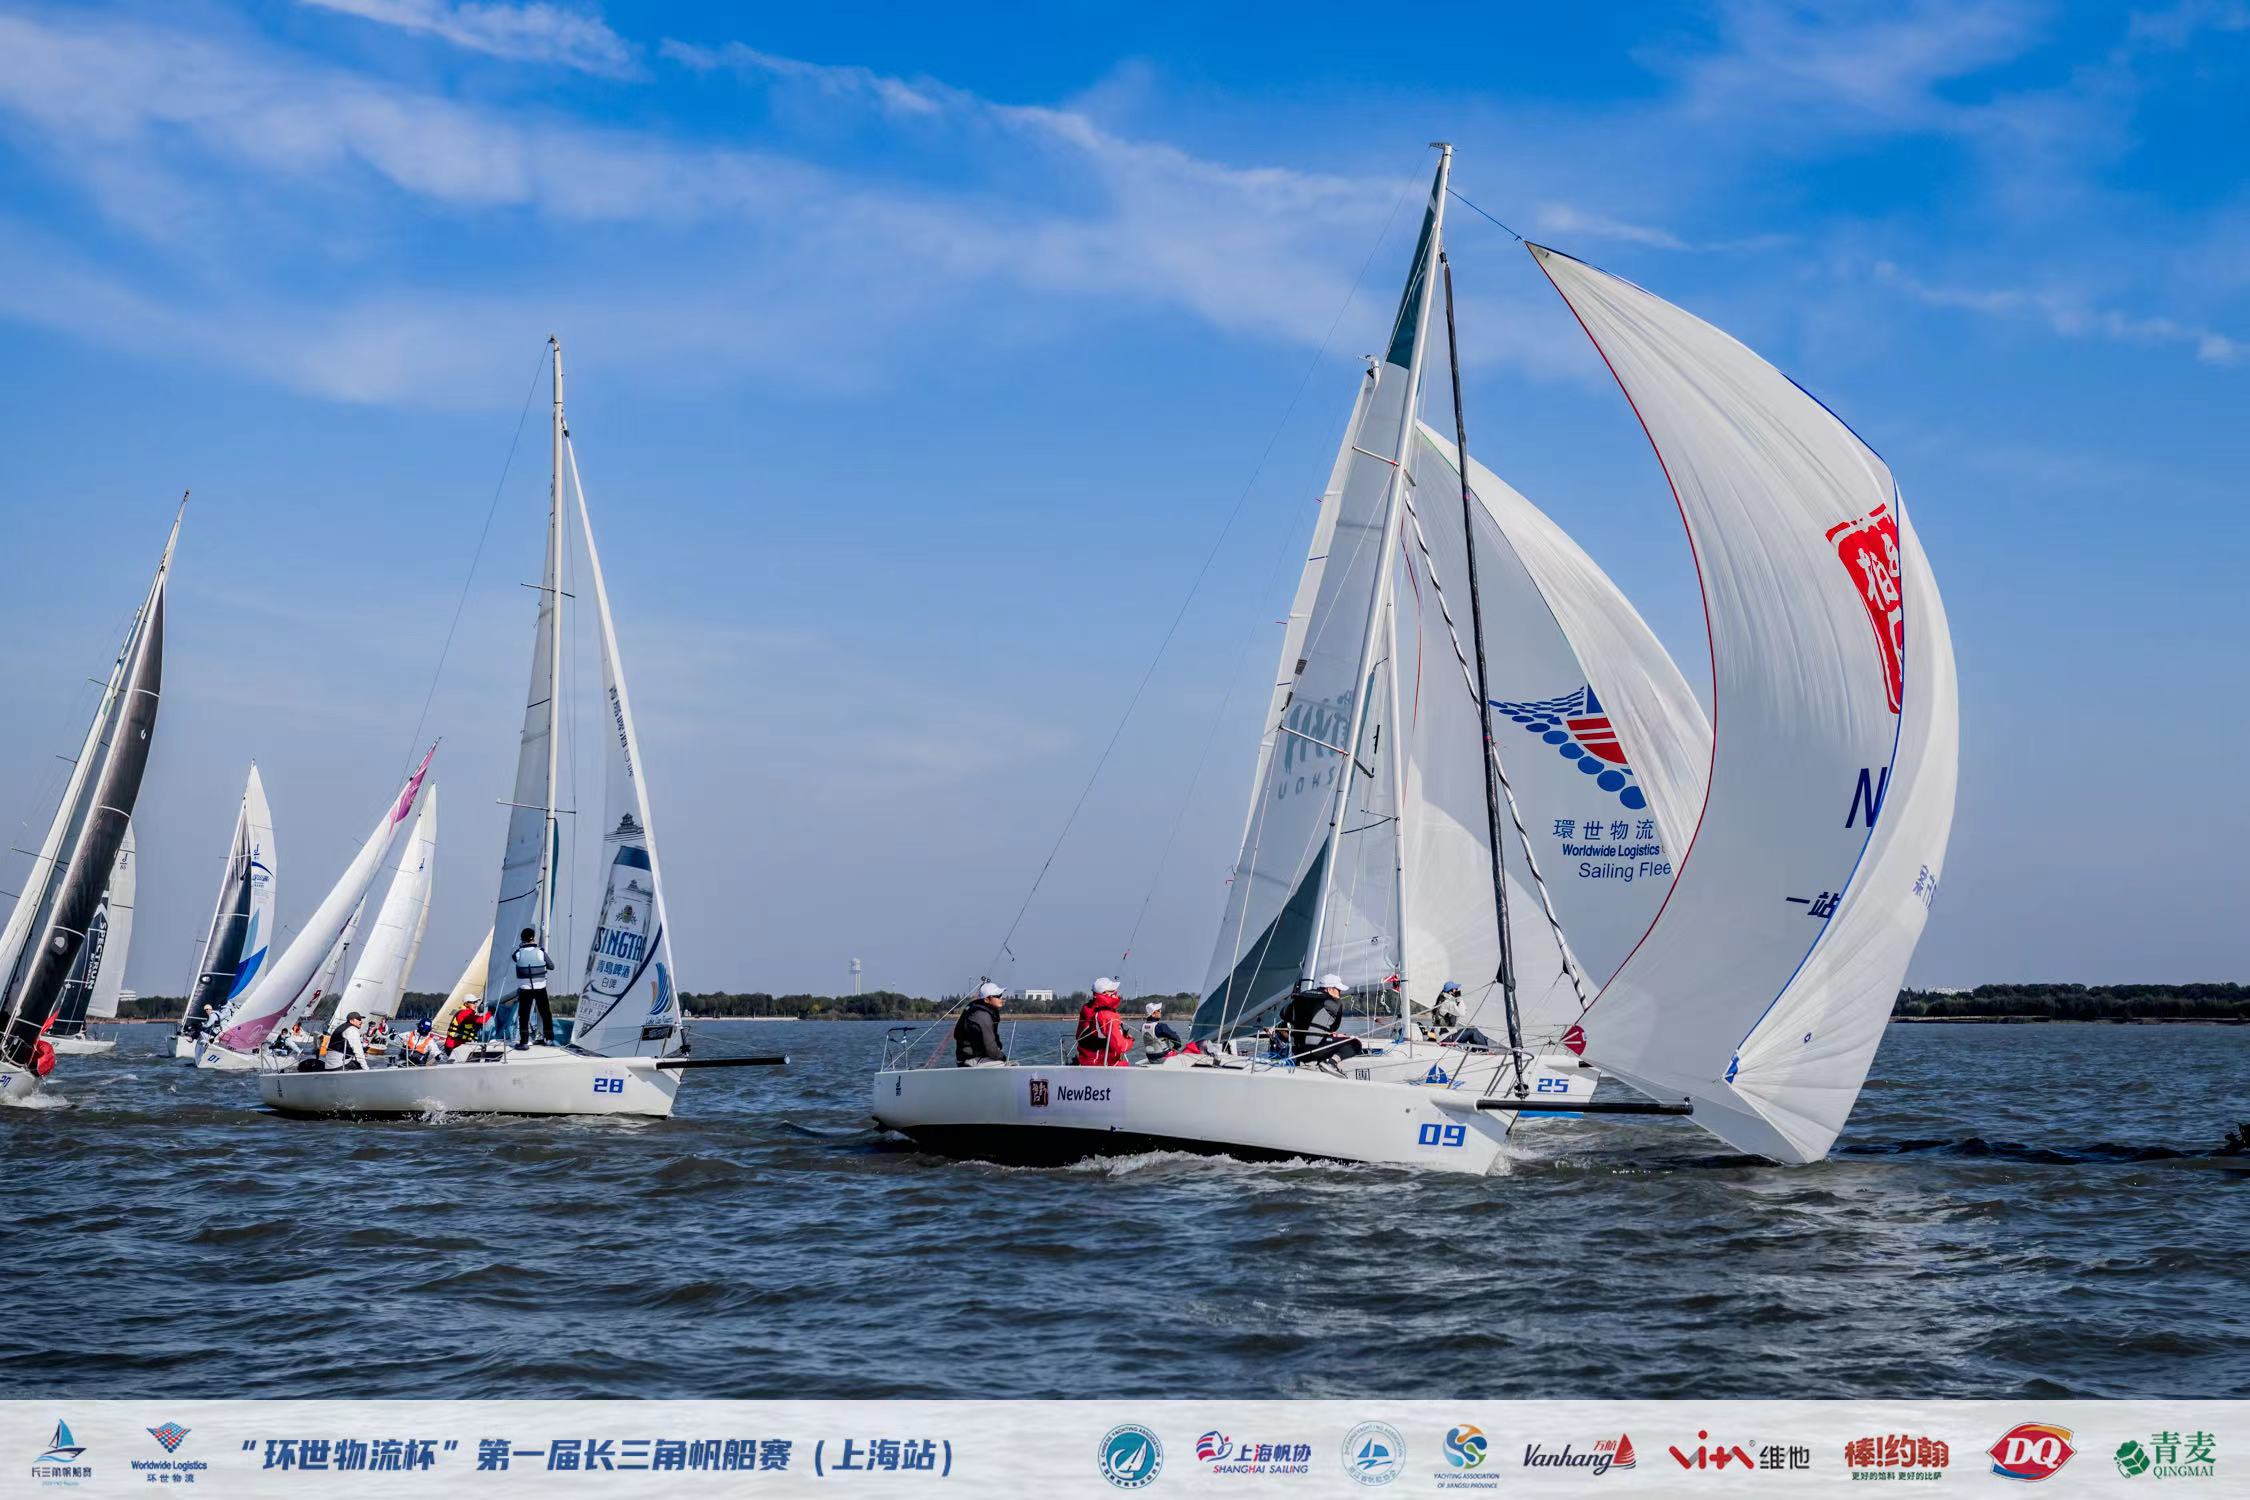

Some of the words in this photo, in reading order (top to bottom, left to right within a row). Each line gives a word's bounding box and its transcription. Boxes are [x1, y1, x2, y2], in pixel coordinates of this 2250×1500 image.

[1845, 766, 1888, 829] N
[1562, 843, 1616, 857] Worldwide
[1618, 844, 1660, 860] Logistics
[1579, 863, 1634, 883] Sailing
[594, 1078, 624, 1093] 28
[1057, 1086, 1111, 1102] NewBest
[1537, 1078, 1569, 1093] 25
[1418, 1124, 1466, 1147] 09
